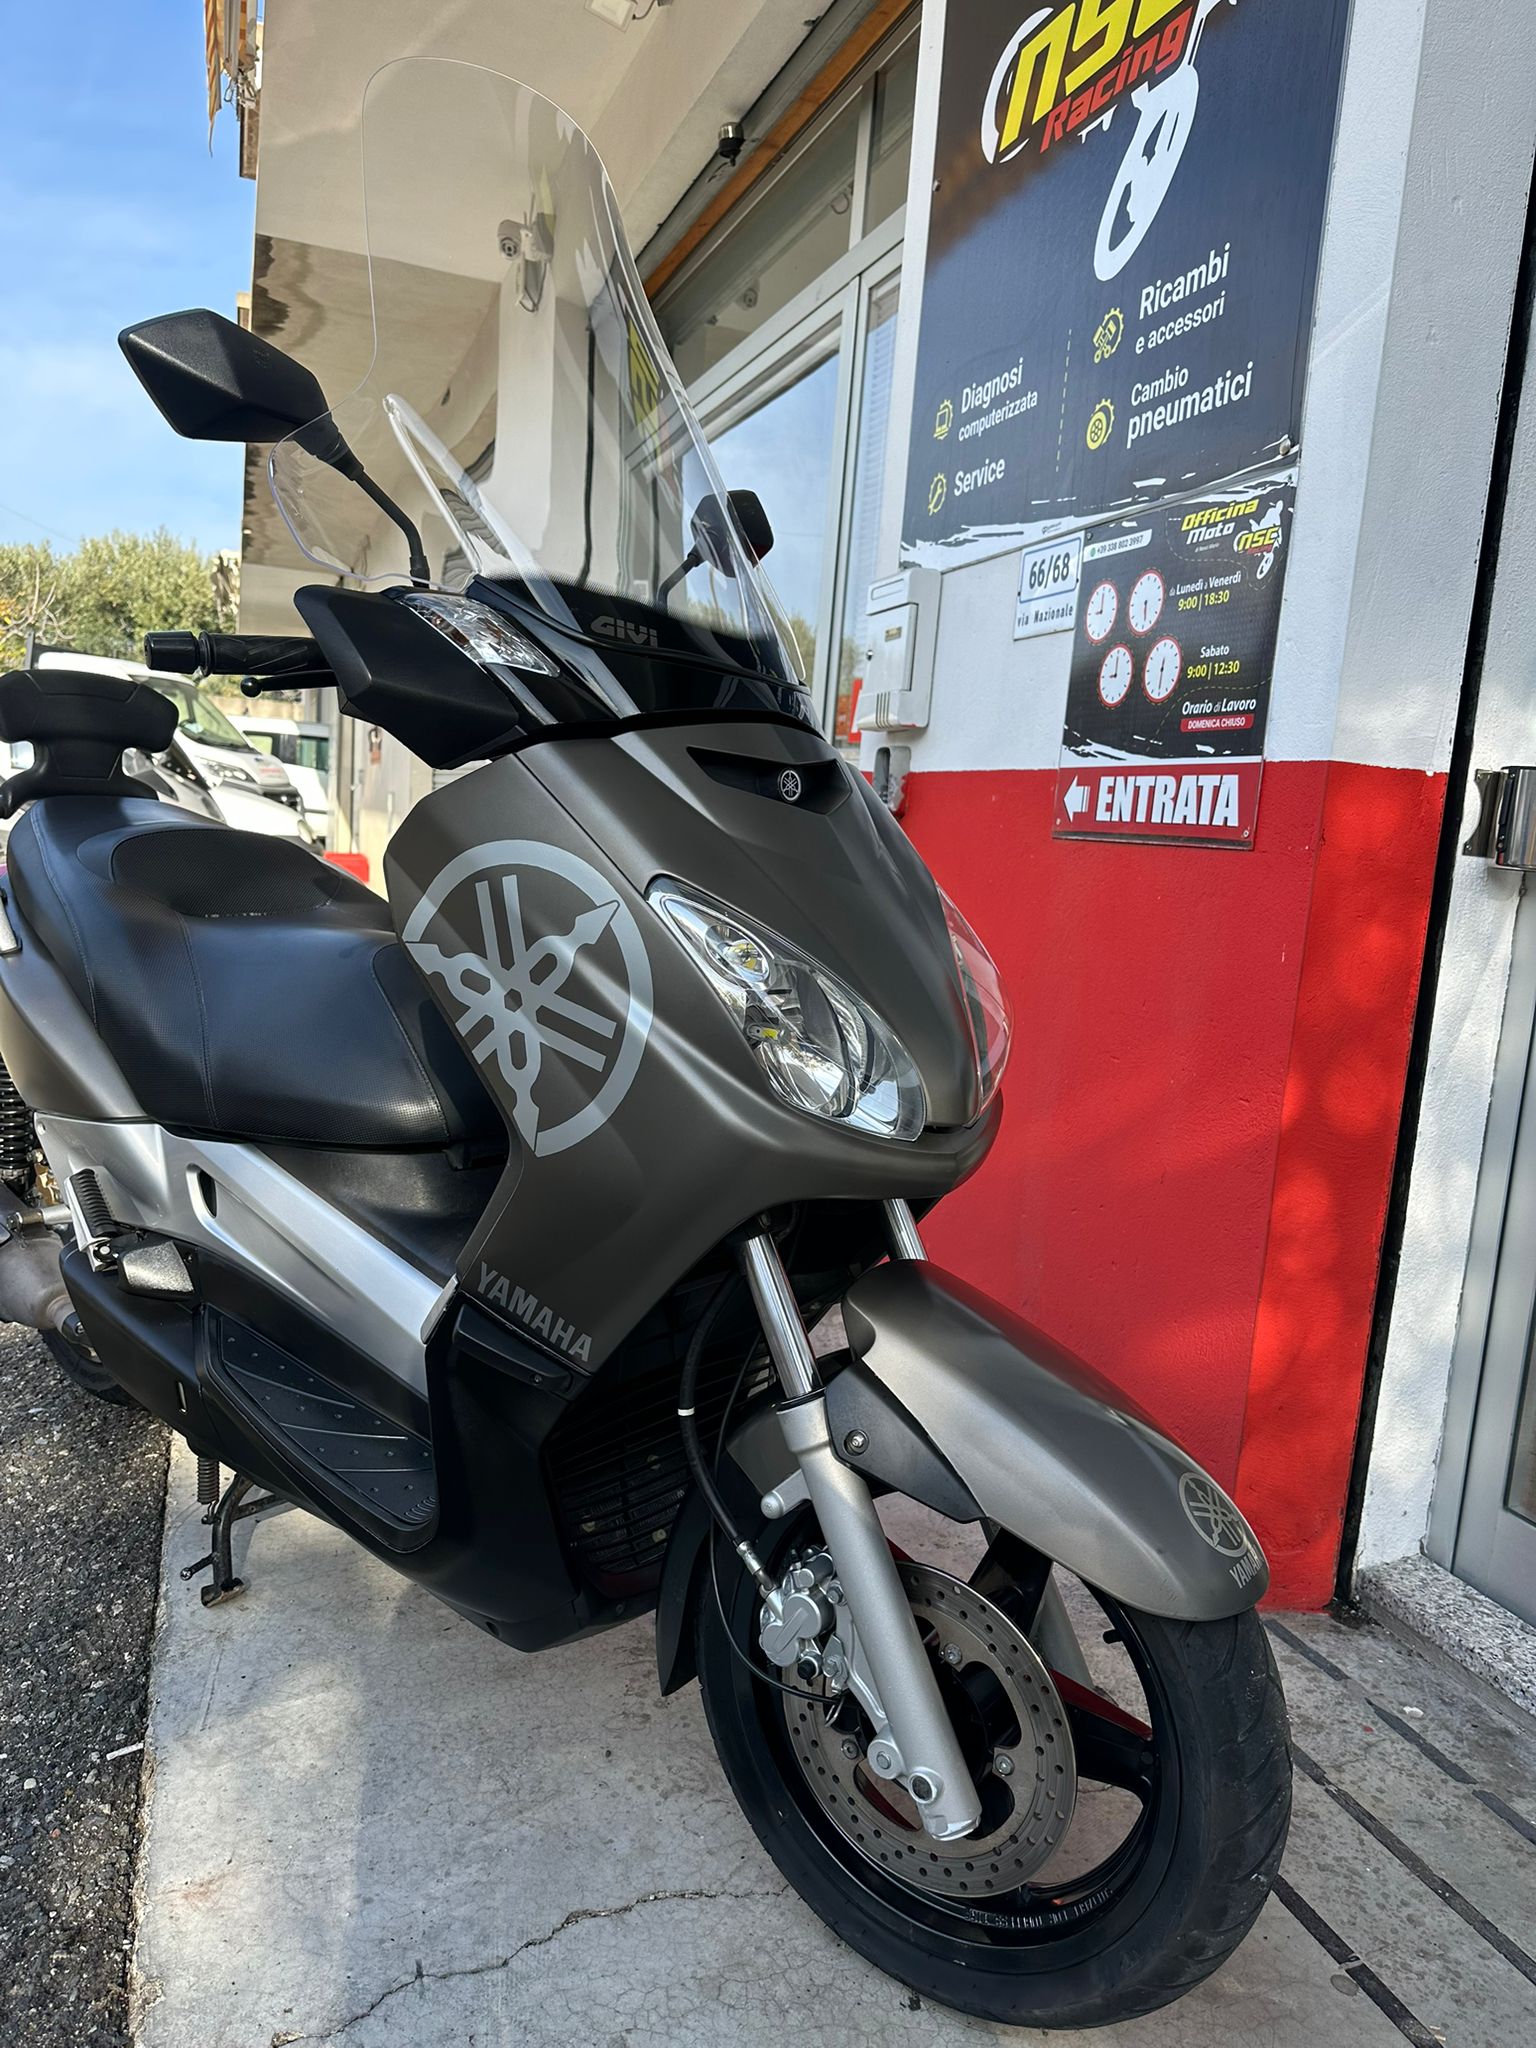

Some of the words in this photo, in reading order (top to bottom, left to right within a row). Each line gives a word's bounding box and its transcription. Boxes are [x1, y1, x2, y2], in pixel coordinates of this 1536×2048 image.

[1040, 6, 1193, 153] Racing
[1139, 242, 1231, 320] Ricambi
[1135, 336, 1145, 355] e
[1147, 290, 1226, 350] accessori
[961, 356, 1024, 414] Diagnosi
[1131, 365, 1189, 407] Cambio
[958, 391, 1038, 442] computerizzata
[1126, 360, 1254, 450] pneumatici
[953, 458, 1006, 496] Service
[1181, 499, 1260, 532] Officina
[1186, 521, 1236, 545] Moto
[1029, 552, 1071, 589] 66/68
[1017, 615, 1029, 627] via
[1033, 603, 1074, 624] Nazionale
[1178, 595, 1198, 611] 9:00
[1204, 590, 1230, 606] 18:30
[590, 615, 658, 648] GIVI
[1187, 664, 1207, 679] 9:00
[1213, 660, 1240, 676] 12:30
[1200, 645, 1230, 659] Sabato
[1182, 699, 1213, 716] Orario
[1221, 698, 1257, 712] Lavoro
[1096, 774, 1239, 827] ENTRATA
[477, 1261, 593, 1362] YAMAHA
